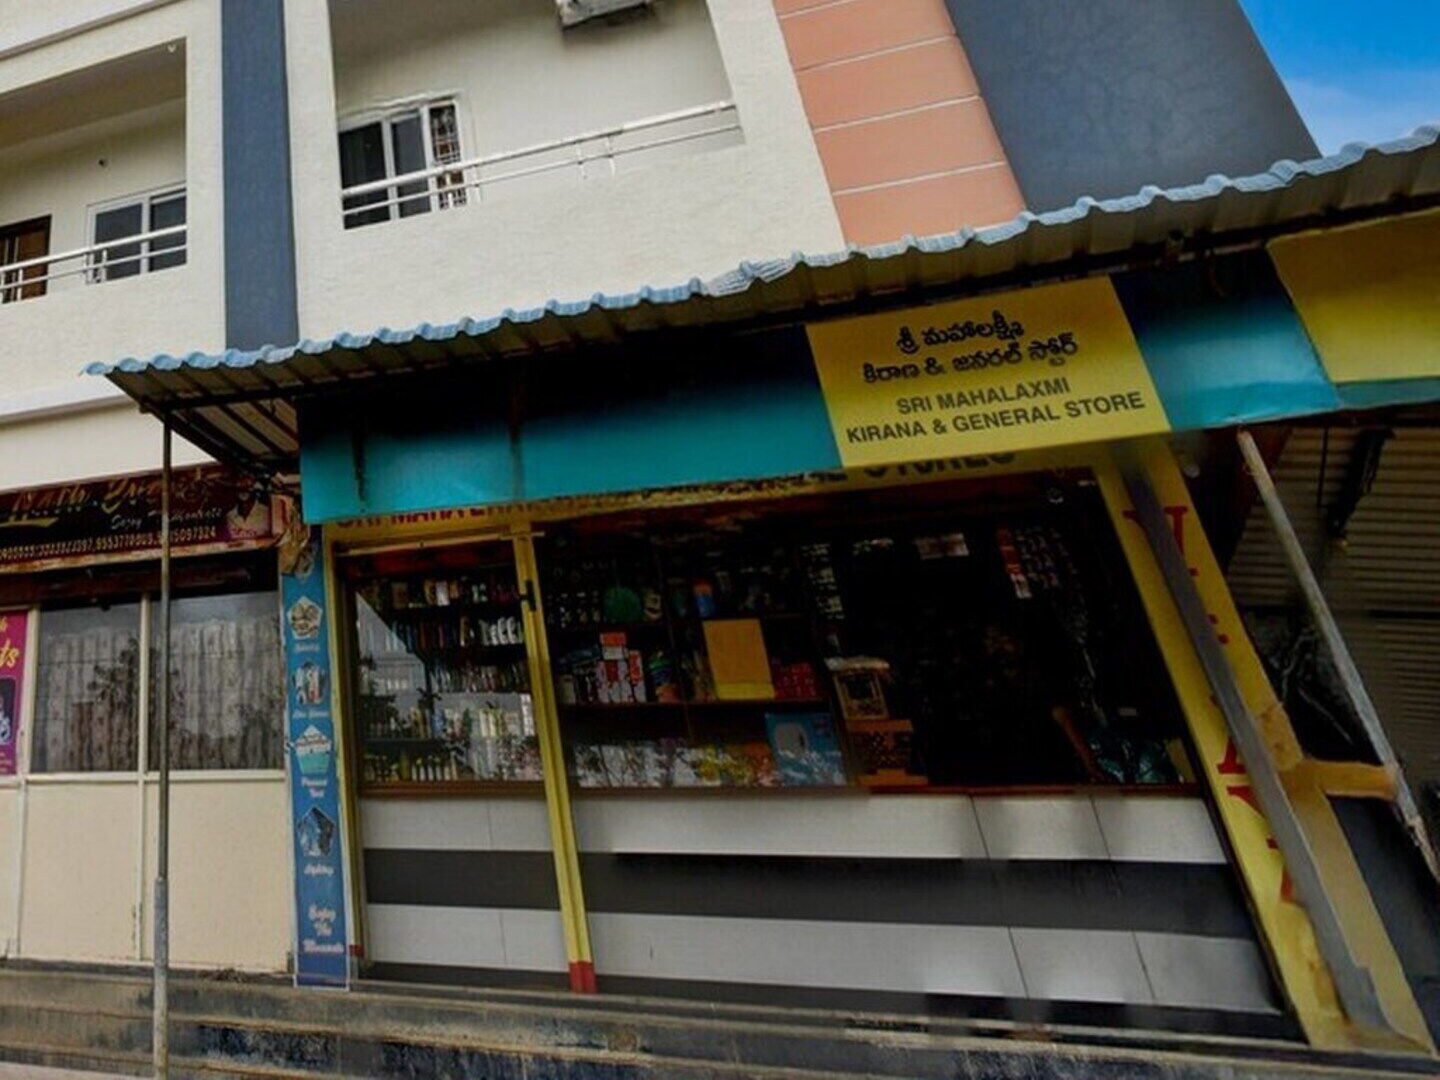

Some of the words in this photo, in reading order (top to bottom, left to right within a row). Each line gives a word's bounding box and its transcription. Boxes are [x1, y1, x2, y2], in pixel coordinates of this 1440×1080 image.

[924, 356, 946, 376] &
[896, 394, 932, 415] SRI
[938, 377, 1072, 410] MAHALAXMI
[846, 417, 927, 444] KIRANA
[933, 411, 948, 434] &
[952, 404, 1062, 432] GENERAL
[1066, 391, 1146, 419] STORE
